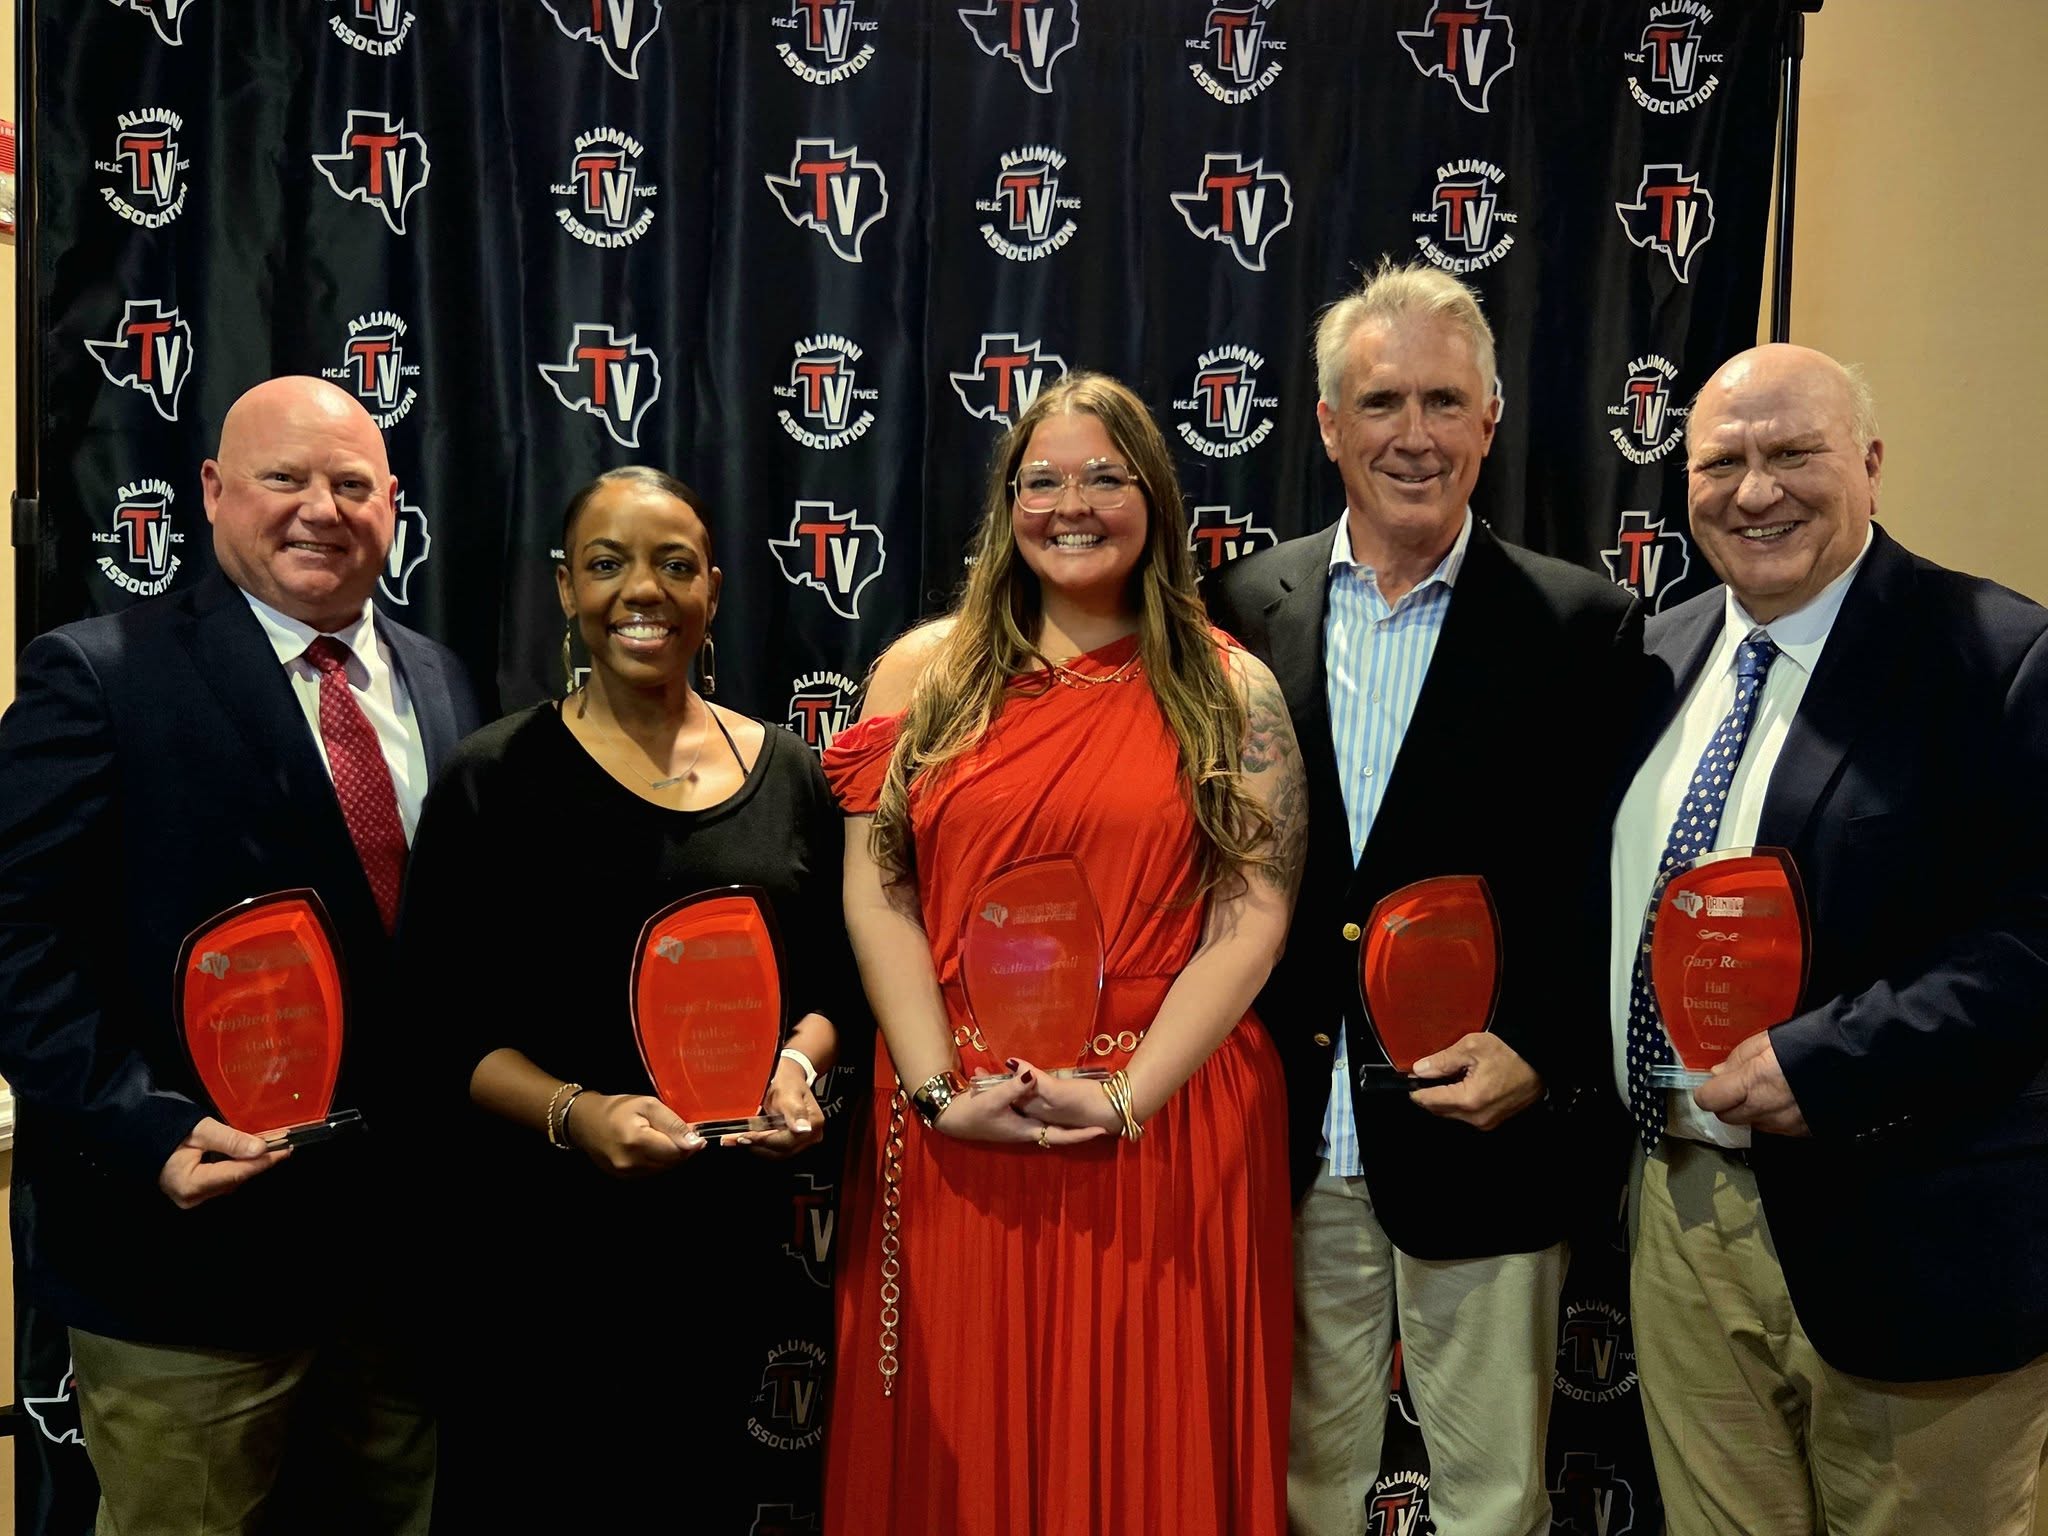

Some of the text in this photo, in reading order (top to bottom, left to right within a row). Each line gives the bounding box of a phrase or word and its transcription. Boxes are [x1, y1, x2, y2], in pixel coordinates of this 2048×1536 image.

[771, 16, 799, 30] HCJC
[852, 20, 879, 31] TVCC
[1649, 0, 1714, 26] ALUMNI
[1185, 39, 1210, 51] HCJC
[1213, 16, 1258, 76] TV
[1261, 40, 1287, 50] TVCC
[1433, 13, 1491, 86] TV
[1623, 51, 1646, 63] HCJC
[1647, 29, 1695, 88] TV
[1697, 53, 1724, 64] TVCC
[776, 42, 876, 85] ASSOCIATION
[1188, 60, 1283, 105] ASSOCIATION
[1627, 74, 1720, 115] ASSOCIATION
[117, 106, 183, 132] ALUMNI
[573, 127, 645, 159] ALUMNI
[95, 160, 124, 174] HCJC
[123, 138, 175, 200] TV
[350, 134, 407, 209] TV
[1000, 146, 1068, 172] ALUMNI
[1436, 158, 1507, 185] ALUMNI
[550, 183, 578, 196] HCJC
[578, 159, 629, 221] TV
[633, 186, 658, 197] TVCC
[798, 161, 861, 236] TV
[1055, 199, 1082, 210] TVCC
[975, 199, 1002, 212] HCJC
[1003, 176, 1048, 234] TV
[1205, 174, 1267, 246] TV
[1412, 212, 1438, 224] HCJC
[1439, 189, 1491, 246] TV
[1494, 212, 1519, 224] TVCC
[556, 207, 656, 249] ASSOCIATION
[1644, 184, 1698, 257] TV
[980, 218, 1078, 262] ASSOCIATION
[1415, 233, 1515, 274] ASSOCIATION
[347, 310, 408, 337] ALUMNI
[126, 321, 181, 395] TV
[794, 333, 863, 362] ALUMNI
[1197, 345, 1265, 371] ALUMNI
[322, 367, 351, 379] HCJC
[351, 342, 398, 402] TV
[400, 365, 420, 376] TVCC
[1627, 353, 1679, 381] ALUMNI
[577, 346, 639, 421] TV
[797, 365, 849, 423] TV
[852, 388, 879, 400] TVCC
[983, 354, 1043, 420] TV
[371, 387, 418, 429] IATION
[1173, 399, 1199, 410] HCJC
[1200, 374, 1249, 432] TV
[1252, 398, 1279, 408] TVCC
[1607, 404, 1630, 416] HCJC
[1630, 382, 1663, 439] TV
[1665, 406, 1690, 417] TVCC
[777, 409, 875, 450] ASSOCIATION
[1176, 417, 1275, 458] ASSOCIATION
[1609, 426, 1684, 465] ASSOCIATION
[117, 478, 175, 504] ALUMNI
[92, 532, 121, 544] HCJC
[120, 509, 168, 569] TV
[798, 523, 860, 593] TV
[1619, 531, 1663, 598] TV
[96, 554, 181, 596] ASSOCIATION
[793, 670, 859, 696] ALUMNI
[795, 700, 843, 750] TV
[1681, 894, 1697, 912] TV
[1682, 954, 1717, 970] Gary
[1704, 981, 1730, 994] Hall
[792, 1195, 834, 1262] TV
[1565, 1299, 1627, 1326] ALUMNI
[1375, 1469, 1431, 1494] ALUMNI
[1376, 1497, 1416, 1536] TV
